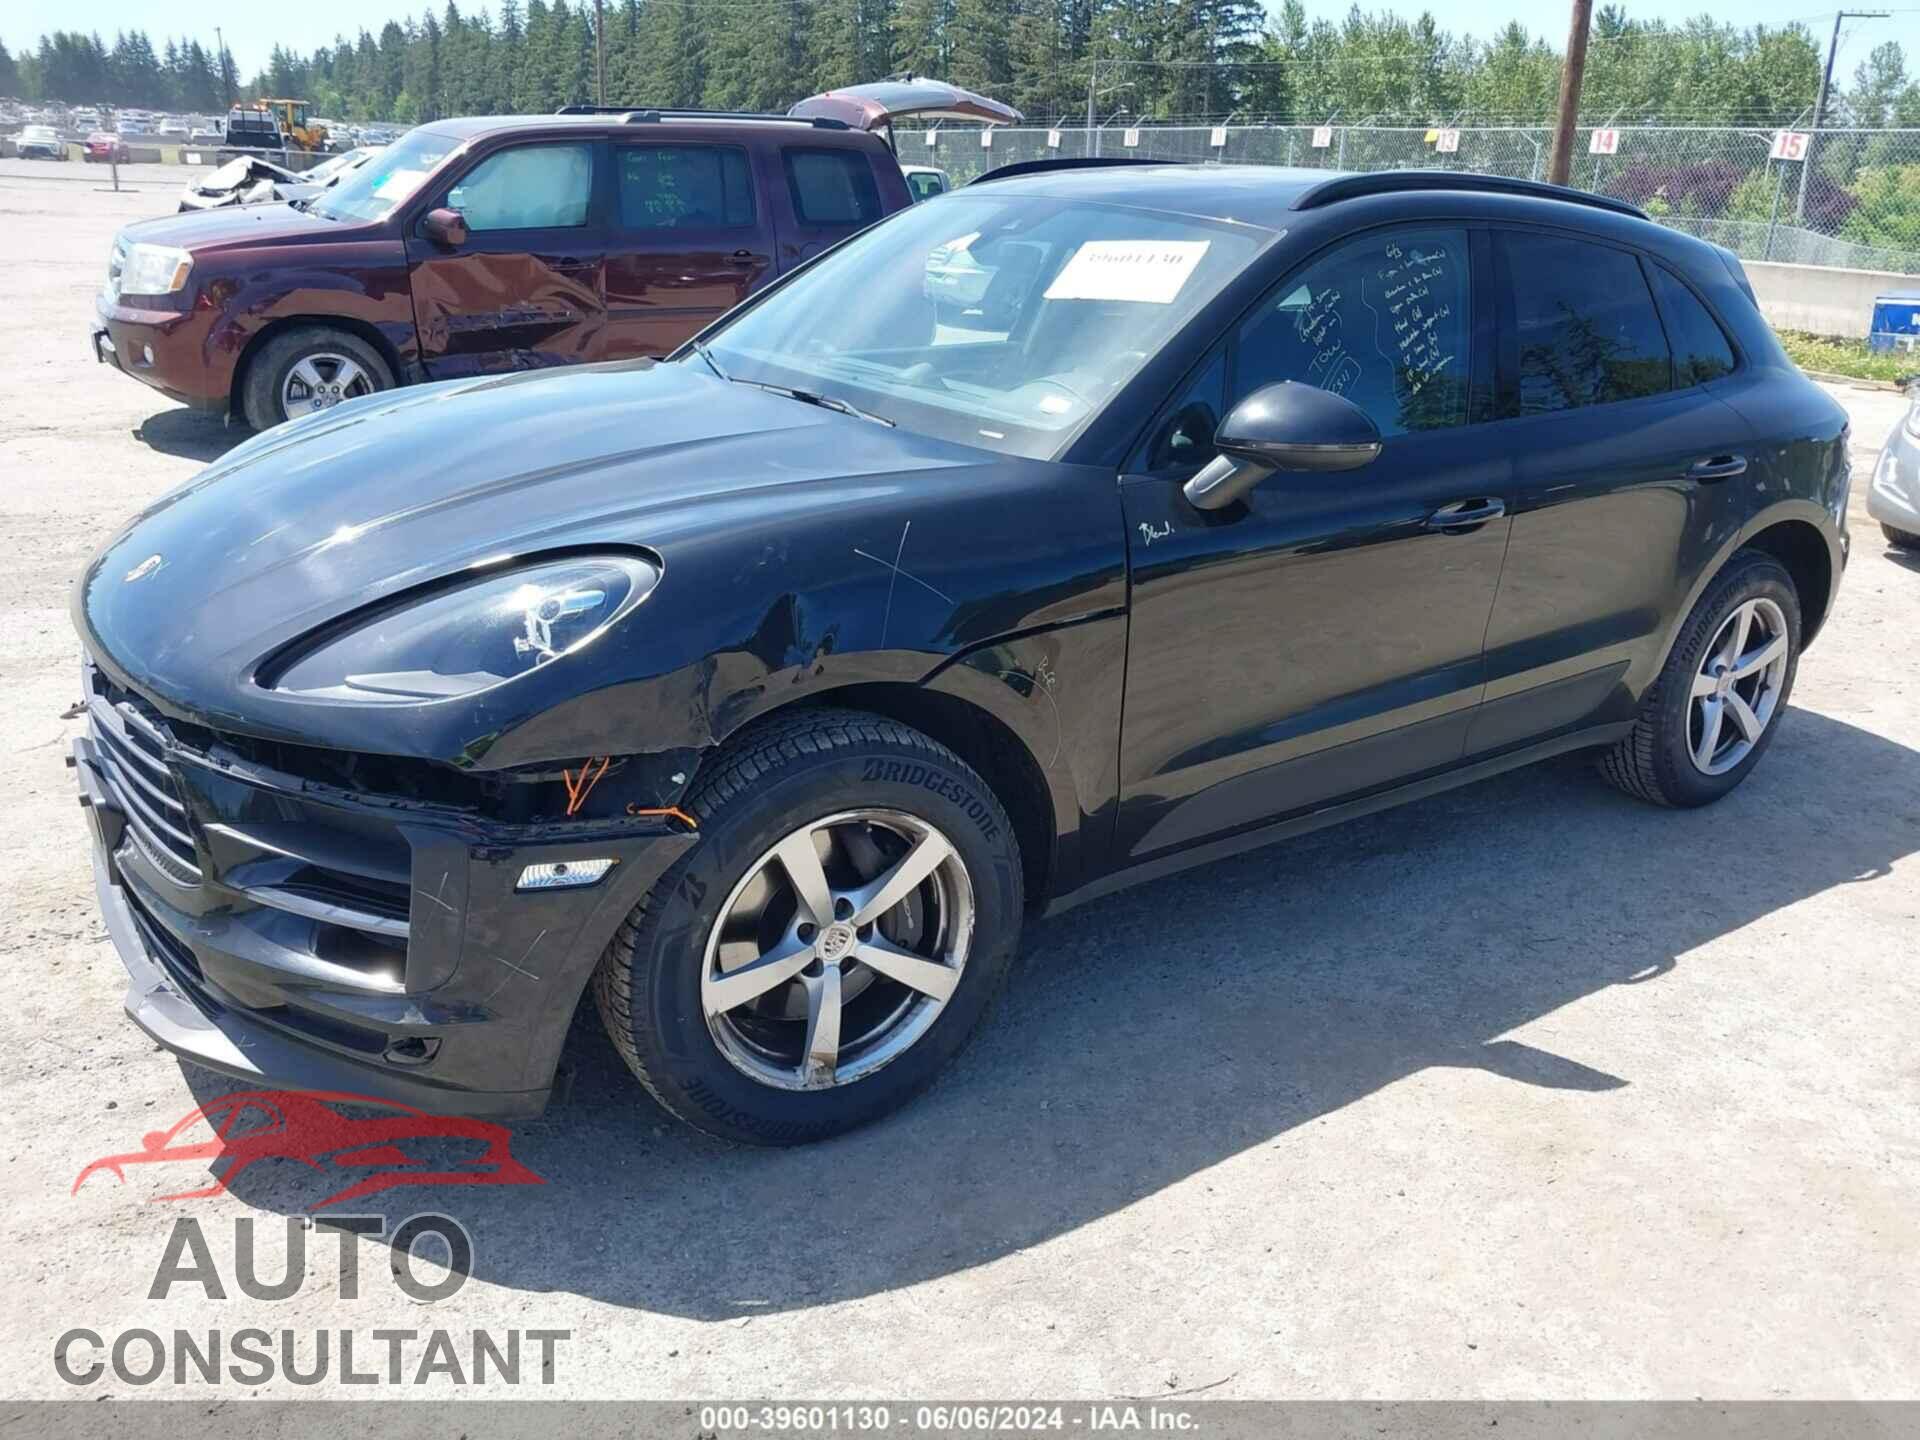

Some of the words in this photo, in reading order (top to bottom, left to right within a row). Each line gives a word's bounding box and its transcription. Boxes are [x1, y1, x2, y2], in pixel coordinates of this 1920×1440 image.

[1317, 128, 1329, 145] 12
[1440, 130, 1456, 150] 13
[1595, 130, 1614, 151] 14
[1780, 134, 1802, 158] 15
[862, 758, 1001, 843] BRIDGESTONE
